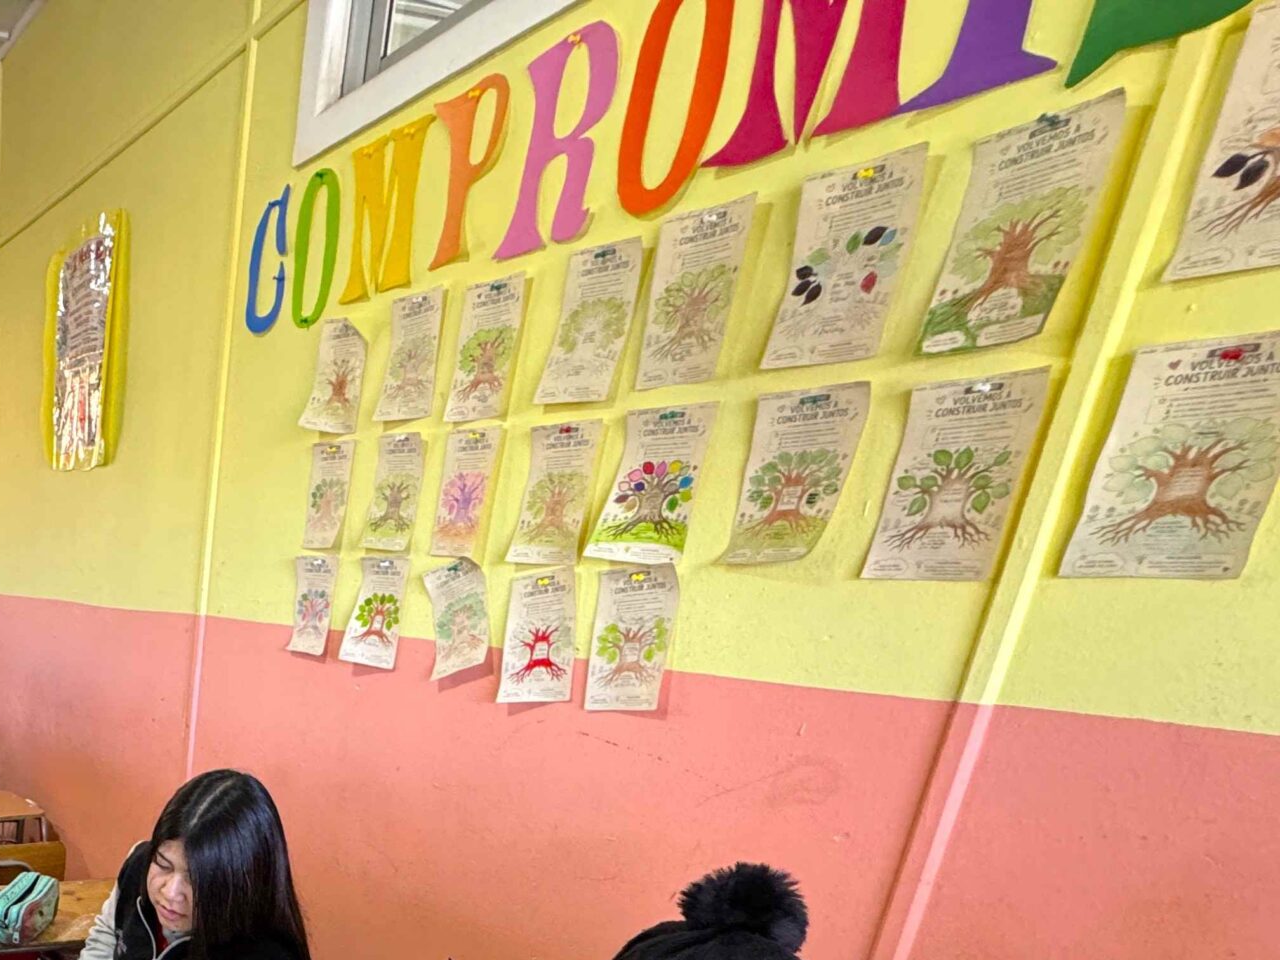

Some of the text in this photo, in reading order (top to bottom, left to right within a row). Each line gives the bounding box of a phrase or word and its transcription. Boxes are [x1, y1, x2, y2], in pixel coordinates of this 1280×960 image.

[245, 0, 1253, 334] COMPROM
[1164, 363, 1280, 387] CONSTRUIR JUNTO
